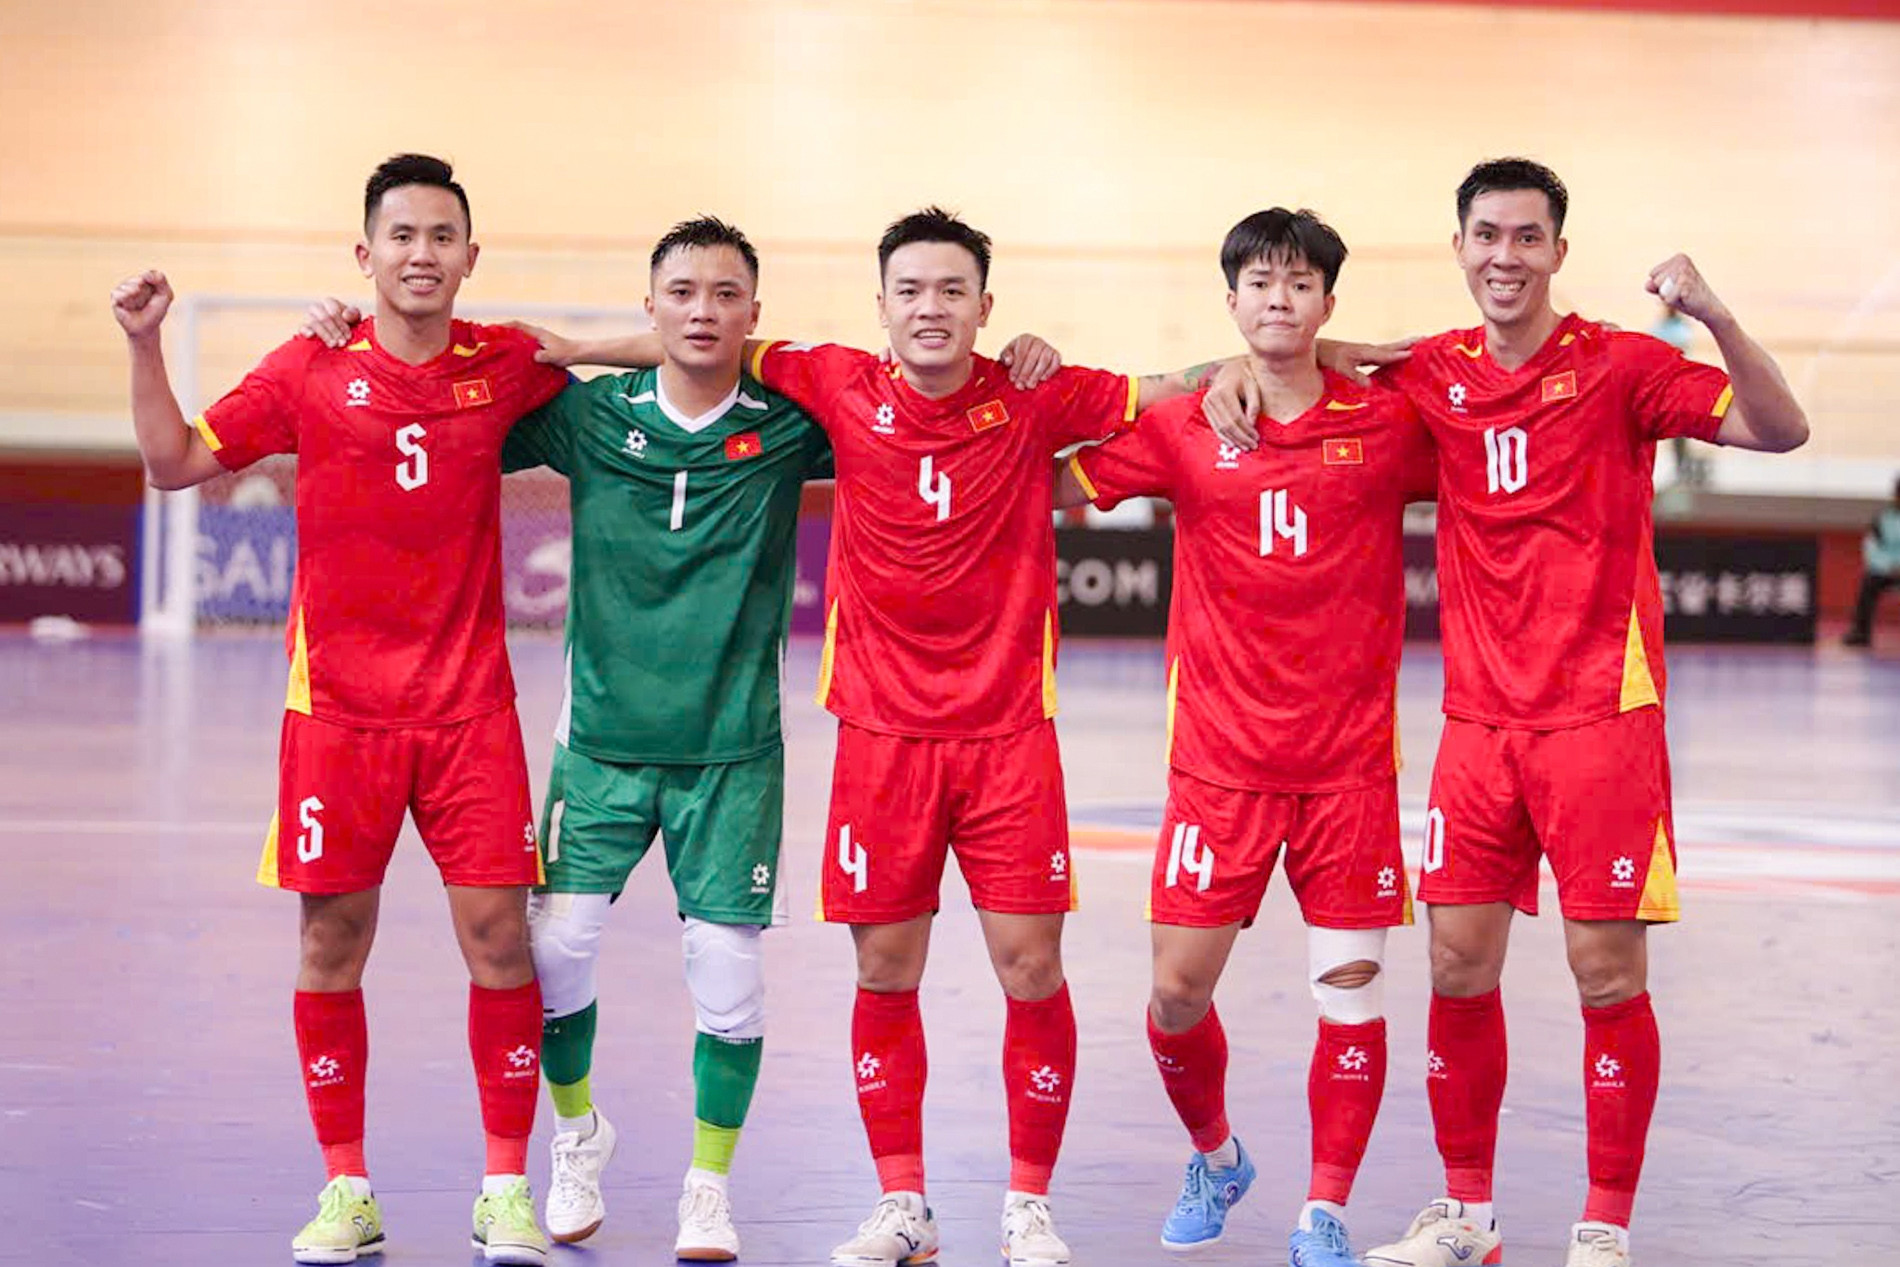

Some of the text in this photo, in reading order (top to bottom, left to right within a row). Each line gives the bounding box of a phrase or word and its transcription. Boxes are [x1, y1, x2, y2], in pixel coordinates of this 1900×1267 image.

[395, 423, 428, 492] 5
[918, 455, 951, 522] 4
[1484, 426, 1528, 494] 10
[670, 470, 688, 532] 1
[1259, 488, 1308, 558] 14
[297, 795, 324, 863] 5
[838, 823, 868, 893] 4
[1165, 822, 1214, 892] 14
